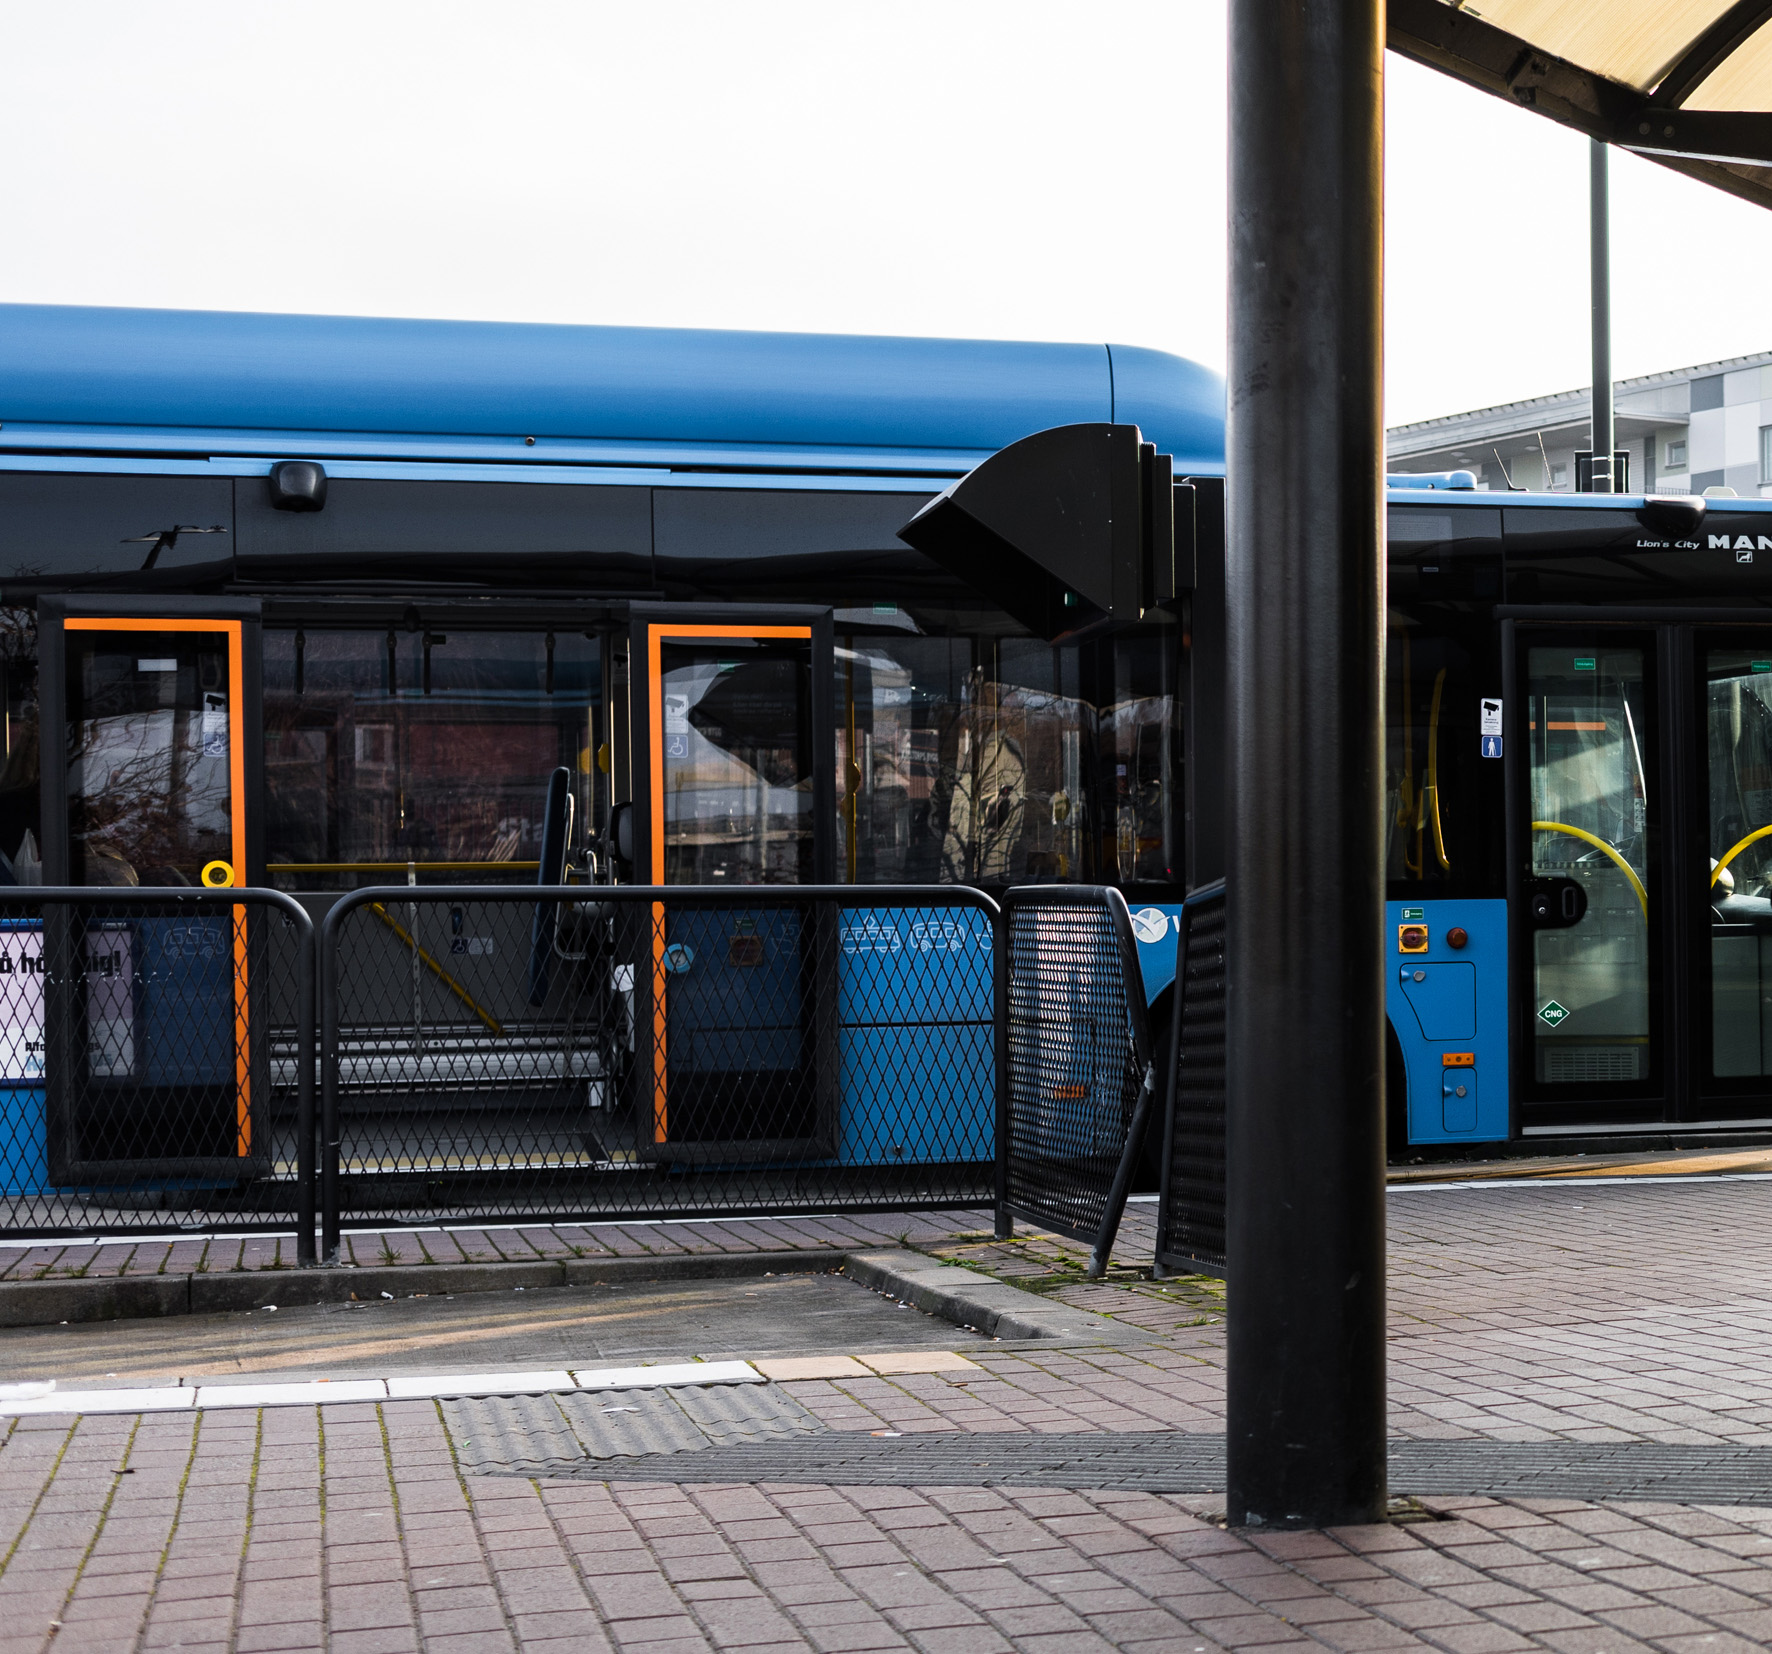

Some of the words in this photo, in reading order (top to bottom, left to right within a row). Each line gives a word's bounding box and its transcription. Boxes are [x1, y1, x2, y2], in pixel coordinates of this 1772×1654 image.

[1637, 540, 1669, 548] Lion's
[1674, 540, 1700, 550] City
[1545, 1010, 1562, 1018] CNG
